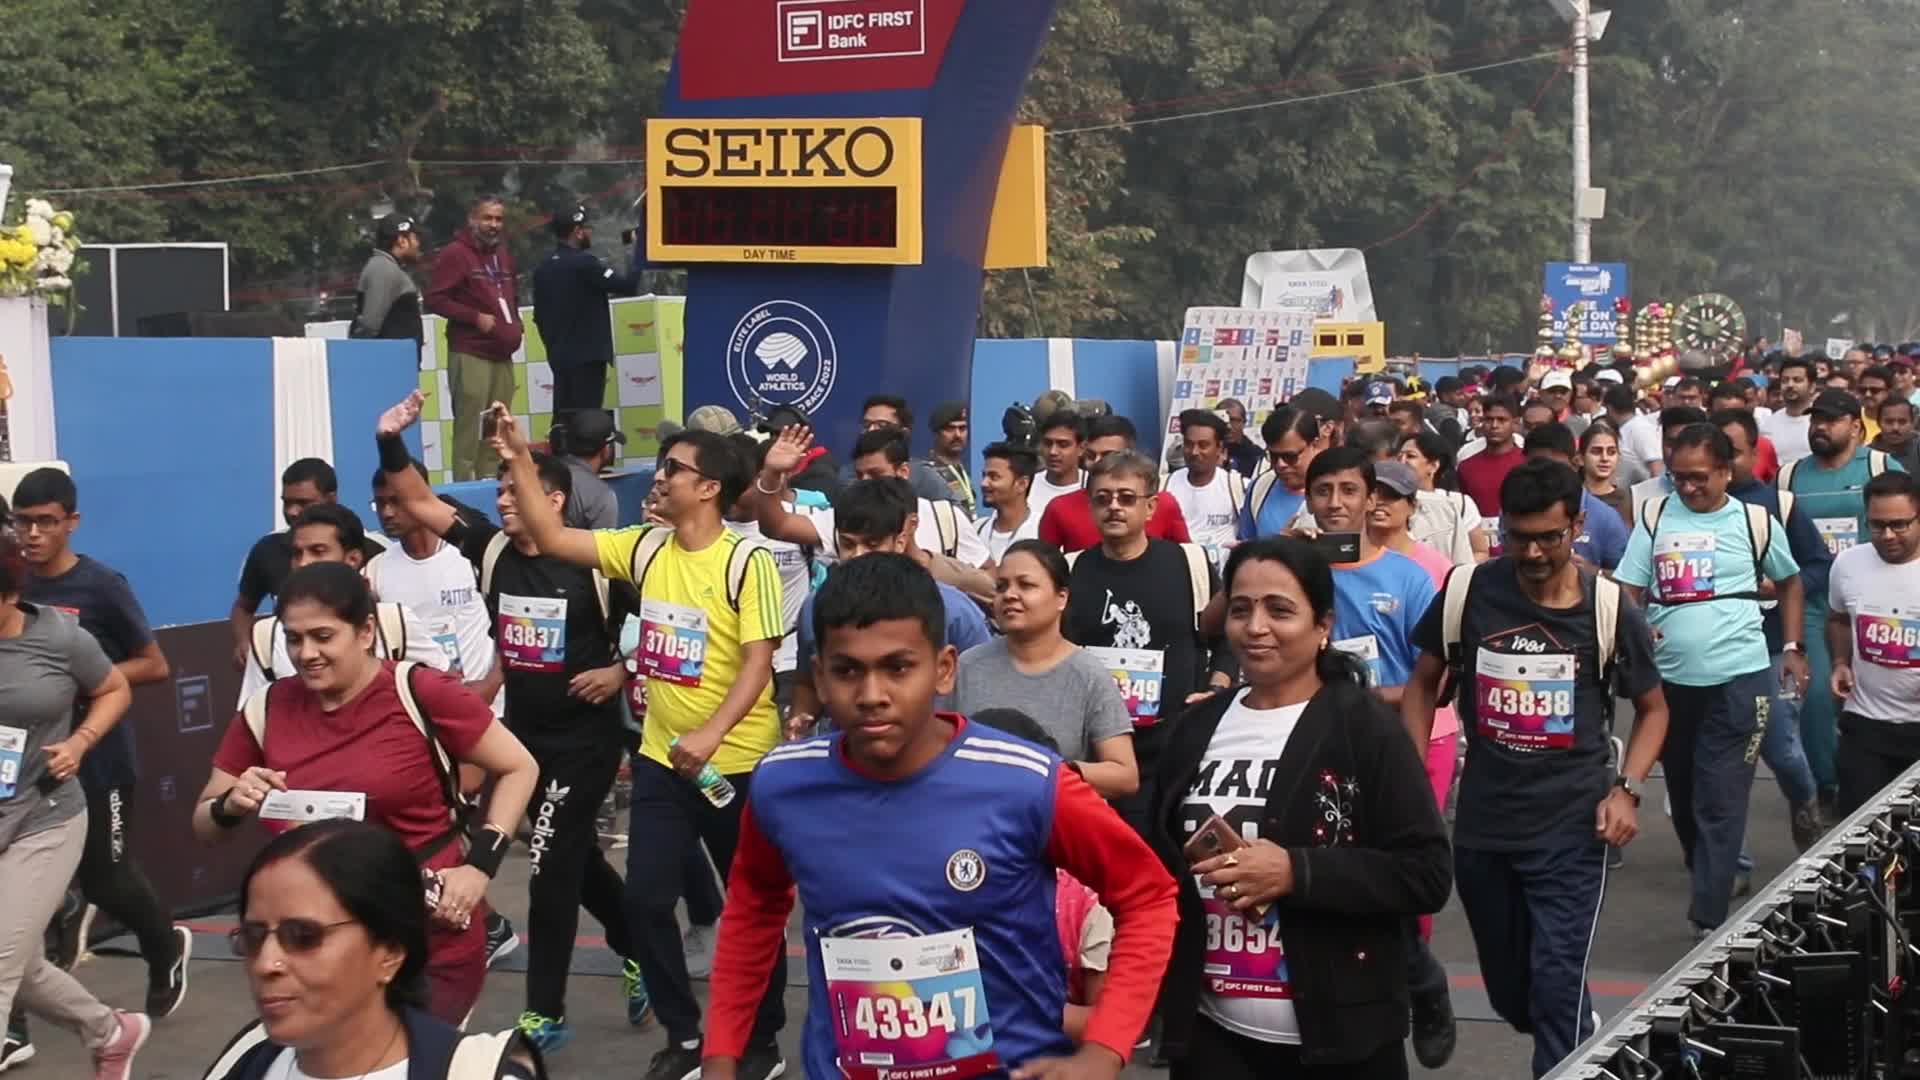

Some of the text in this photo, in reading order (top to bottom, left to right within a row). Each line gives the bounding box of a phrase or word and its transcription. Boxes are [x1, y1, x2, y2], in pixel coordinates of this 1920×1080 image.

[828, 11, 914, 30] IDFC FIRST
[828, 33, 867, 48] Bank
[665, 126, 894, 178] SEIKO
[743, 248, 796, 261] DAY TIME
[1590, 311, 1610, 321] ON
[1590, 321, 1617, 331] DAY
[733, 309, 772, 353] ELITE LABEL
[758, 382, 806, 391] ATHLETICS
[765, 373, 798, 382] WORLD
[804, 360, 832, 408] RACE 2022
[1658, 558, 1713, 580] 36712
[504, 624, 561, 649] 43837
[646, 630, 703, 662] 37058
[1112, 677, 1160, 702] 349
[1488, 687, 1571, 717] 43838
[856, 986, 977, 1040] 43347
